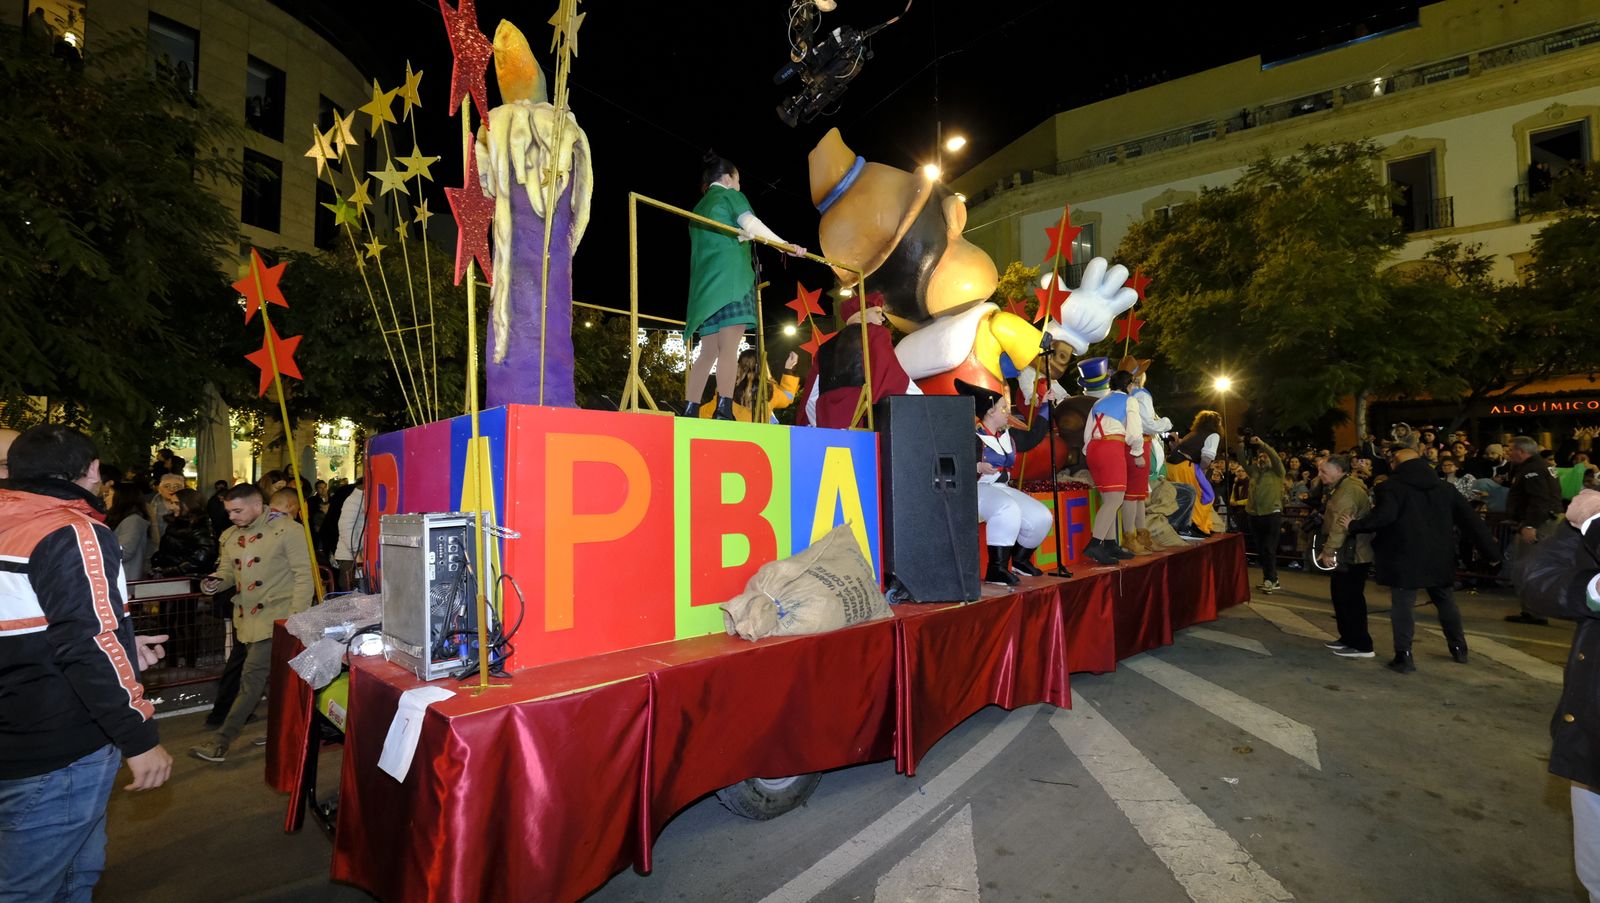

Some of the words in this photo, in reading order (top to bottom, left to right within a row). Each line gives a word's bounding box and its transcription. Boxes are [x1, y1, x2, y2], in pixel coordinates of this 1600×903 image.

[545, 433, 652, 632] P
[690, 438, 778, 607] B
[1066, 497, 1089, 560] F
